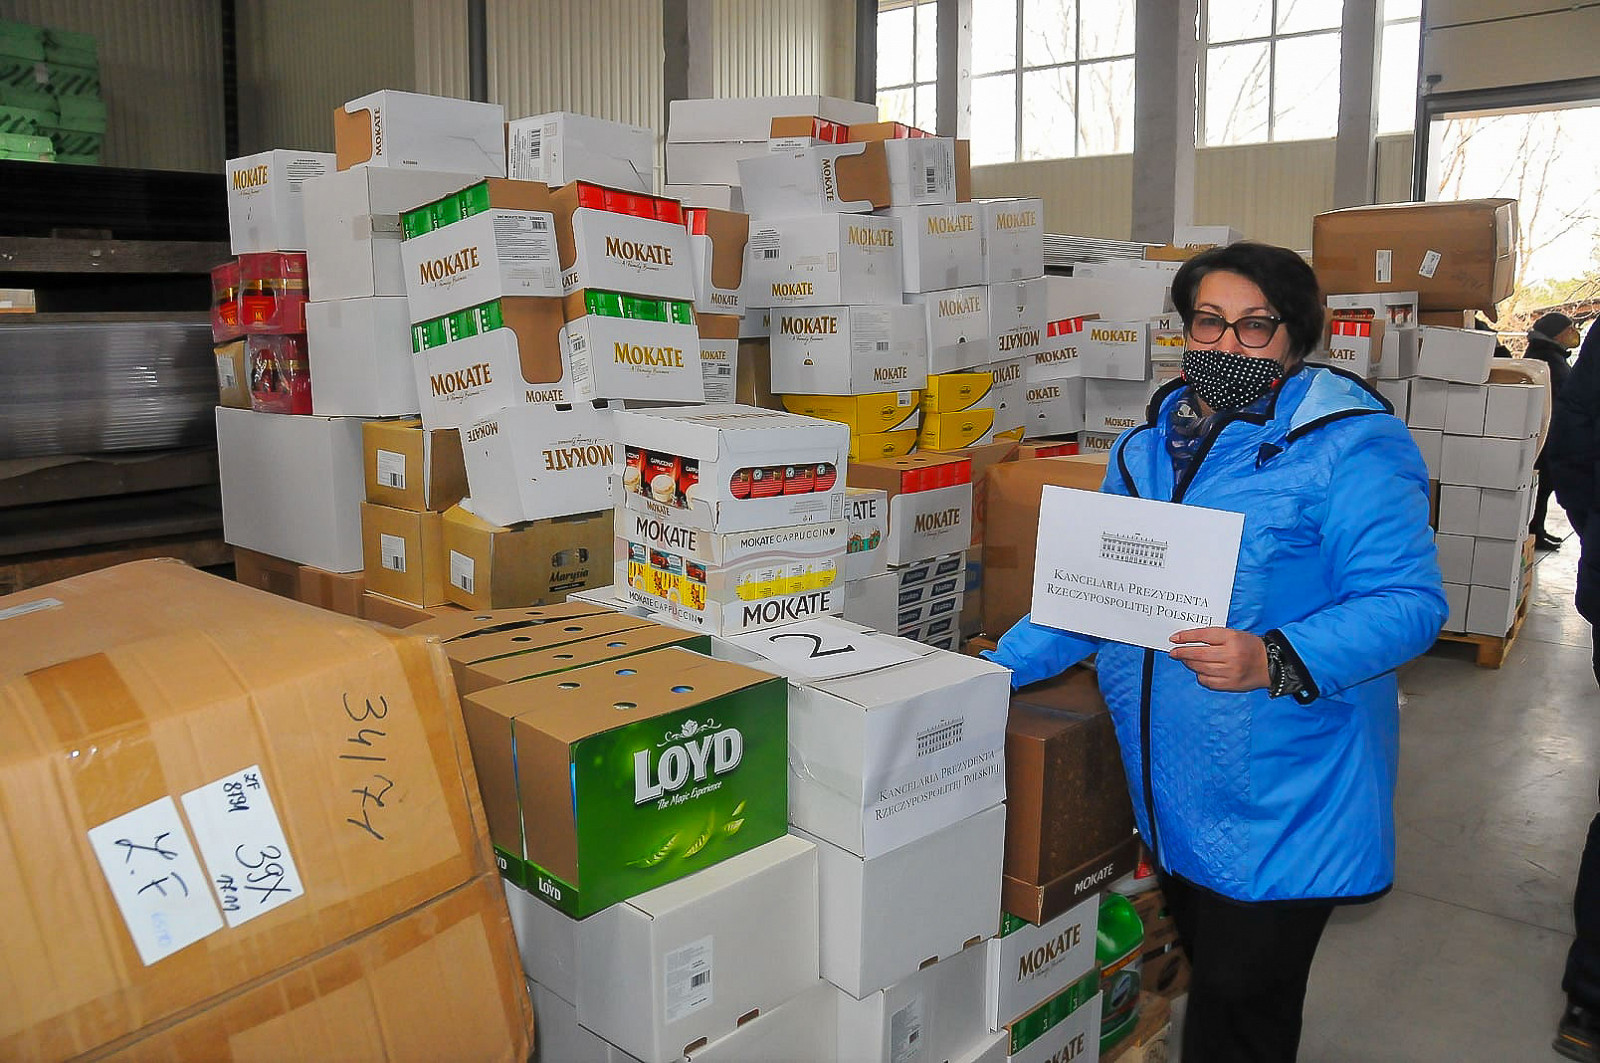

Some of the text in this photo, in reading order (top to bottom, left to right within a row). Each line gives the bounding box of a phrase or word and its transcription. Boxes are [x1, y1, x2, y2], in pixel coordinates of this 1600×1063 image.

[374, 107, 382, 155] MOKATE
[233, 165, 268, 190] MOKATE
[822, 158, 835, 201] MOKATE
[927, 214, 974, 235] MOKATE
[996, 210, 1036, 232] MOKATE
[848, 225, 894, 248] MOKATE
[605, 236, 674, 266] MOKATE
[420, 246, 480, 285] MOKATE
[710, 293, 738, 306] MOKATE
[772, 282, 814, 297] MOKATE
[938, 296, 981, 318] MOKATE
[781, 315, 838, 335] MOKATE
[1090, 328, 1138, 342] MOKATE
[998, 329, 1040, 351] MOKATE
[613, 341, 685, 368] MOKATE
[1035, 346, 1079, 364] MOKATE
[430, 362, 493, 398] MOKATE
[873, 366, 908, 382] MOKATE
[986, 364, 1020, 385] OKATE
[525, 389, 565, 403] MOKATE
[466, 421, 499, 443] MOKATE
[1104, 416, 1136, 428] MOKATE
[541, 444, 614, 471] MOKATE
[646, 500, 670, 517] MOKATE
[914, 508, 960, 533] MOKATE
[636, 516, 698, 551] MOKATE
[740, 534, 775, 549] MOKATE
[549, 567, 589, 583] Marysia
[1053, 567, 1209, 608] KANCELARIA PREZYDENTA
[628, 590, 654, 607] MOKATE
[742, 590, 831, 628] MOKATE
[1046, 582, 1214, 627] RZECZYPOSPOLITEJ POLSKIEJ
[768, 632, 857, 659] 2
[633, 726, 745, 805] LOYD
[879, 749, 996, 802] KANCELARIA PREZYDENTA
[657, 780, 722, 811] The Magic Experience
[875, 763, 1001, 821] RZECZYPOSPOLITEJ POLSKIEJ
[538, 875, 561, 901] LOYD
[1073, 862, 1115, 896] MOKATE
[1016, 923, 1082, 983] MOKATE
[1044, 1031, 1085, 1063] KATE
